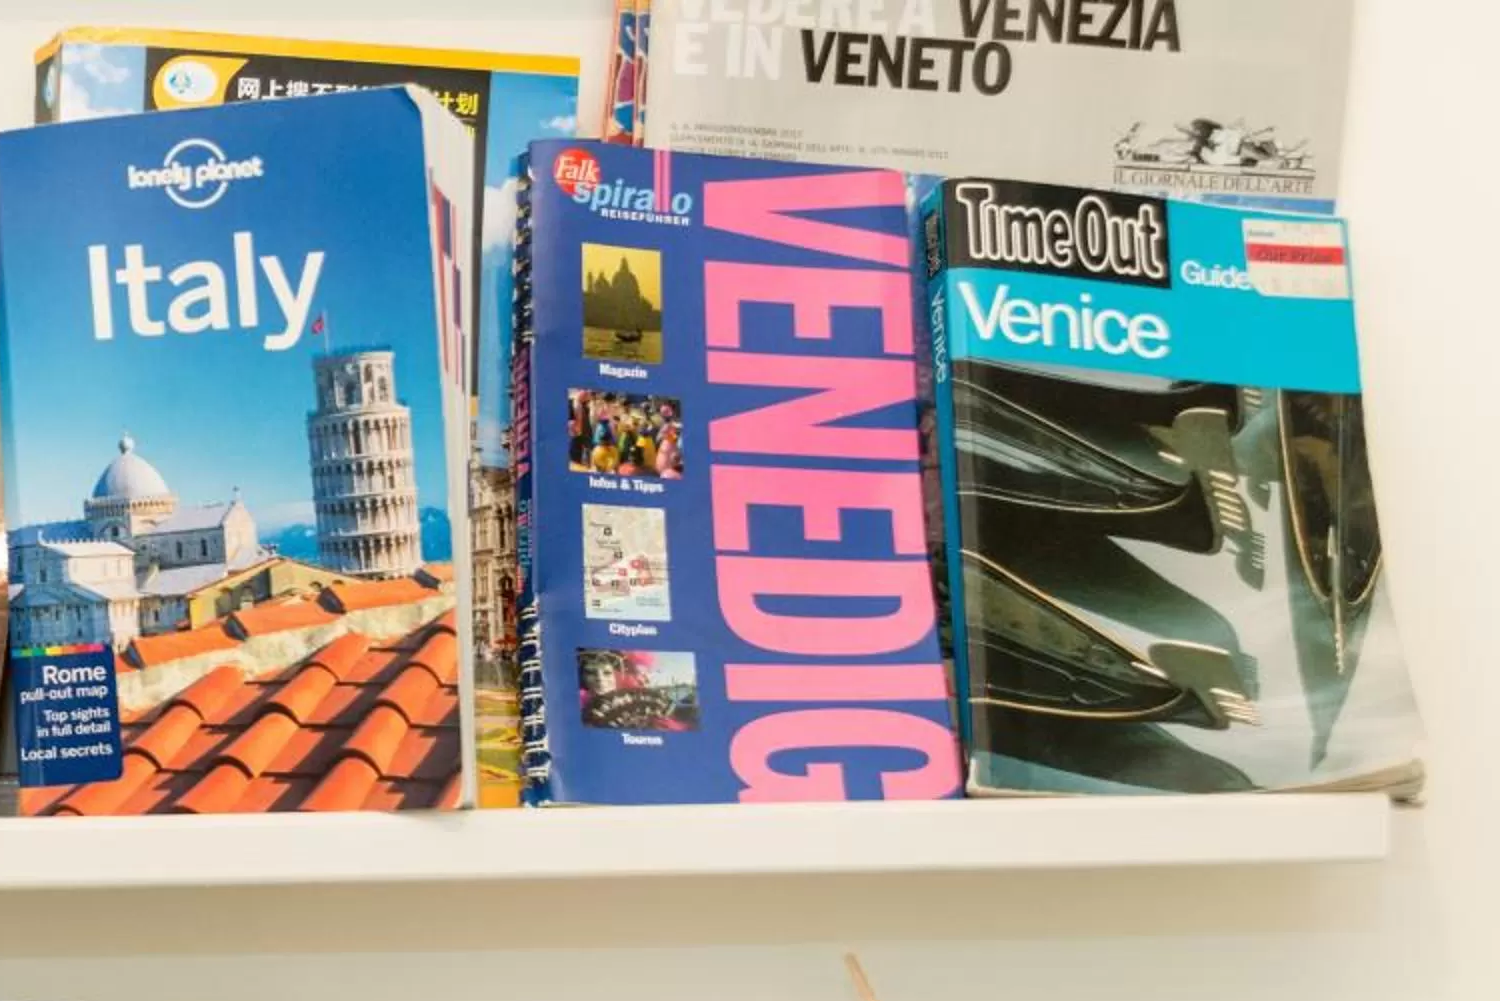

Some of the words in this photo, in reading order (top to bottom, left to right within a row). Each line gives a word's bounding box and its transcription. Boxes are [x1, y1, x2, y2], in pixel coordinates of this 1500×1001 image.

[897, 0, 937, 37] A
[958, 0, 1182, 52] VENEZIA
[674, 23, 709, 76] E
[725, 24, 783, 80] IN
[800, 29, 1013, 96] VENETO
[127, 164, 193, 190] lonely
[195, 154, 264, 186] planet
[554, 155, 600, 182] Falk
[1131, 170, 1218, 191] GIORNALE
[86, 231, 326, 352] Italy
[958, 281, 1171, 360] Venice
[599, 363, 649, 380] Magazin
[703, 170, 964, 803] VENEDIG
[42, 664, 108, 686] Rome
[19, 687, 74, 705] pull-out
[75, 685, 109, 700] map
[43, 709, 69, 723] Top
[70, 706, 111, 723] sights
[36, 726, 49, 738] in
[51, 724, 73, 737] full
[74, 721, 112, 735] detail
[21, 746, 58, 762] Local
[60, 742, 114, 759] secrets
